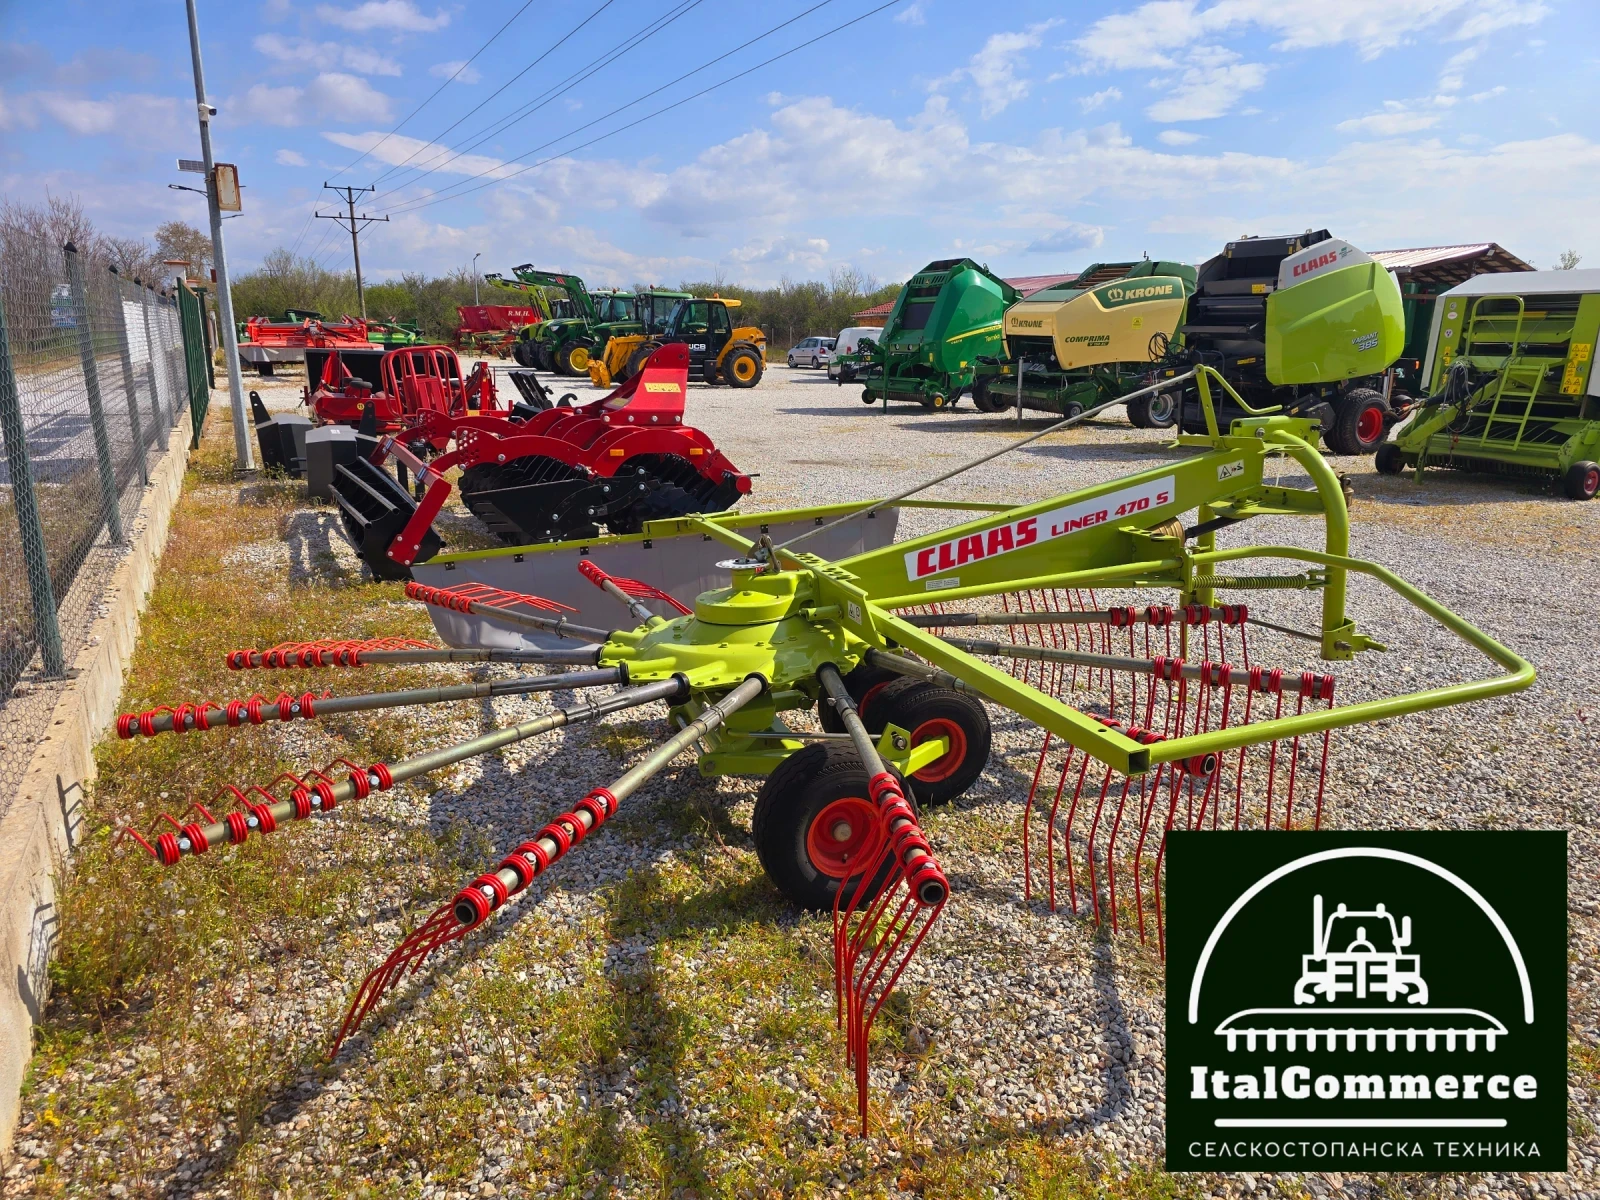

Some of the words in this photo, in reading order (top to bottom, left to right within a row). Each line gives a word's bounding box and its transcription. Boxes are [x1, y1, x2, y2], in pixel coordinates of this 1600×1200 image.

[1293, 251, 1337, 277] CLAAS
[1125, 285, 1173, 300] KRONE
[1018, 320, 1044, 328] KRONE
[1064, 335, 1110, 343] COMPRIMA
[1351, 331, 1379, 345] VARIANT
[1358, 339, 1378, 352] 385
[916, 517, 1038, 577] CLAAS
[1051, 509, 1108, 537] LINER
[1114, 497, 1150, 517] 470
[1156, 491, 1169, 505] S
